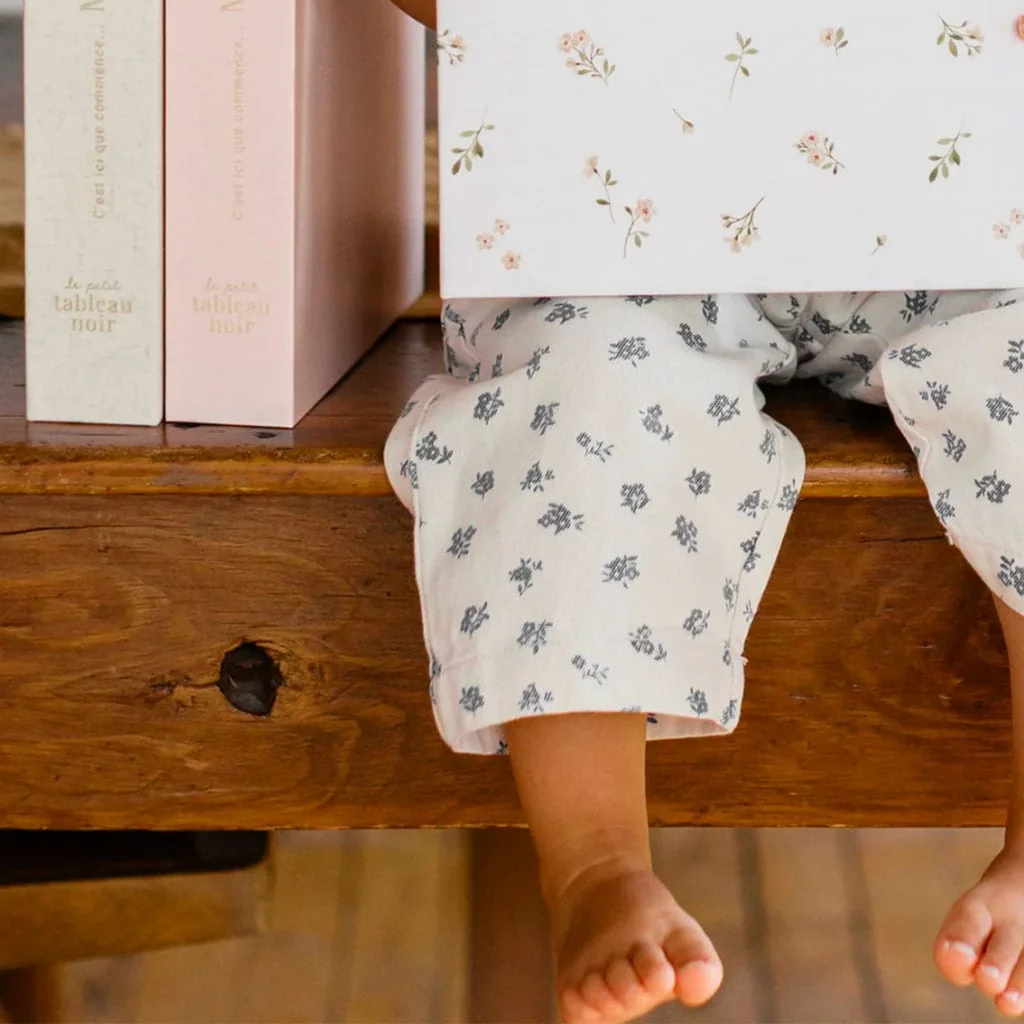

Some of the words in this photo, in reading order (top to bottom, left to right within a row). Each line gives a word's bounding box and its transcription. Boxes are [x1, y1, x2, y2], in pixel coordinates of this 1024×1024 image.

[94, 126, 107, 155] que
[53, 294, 134, 314] tableau
[192, 295, 271, 317] tableau
[71, 314, 117, 333] noir
